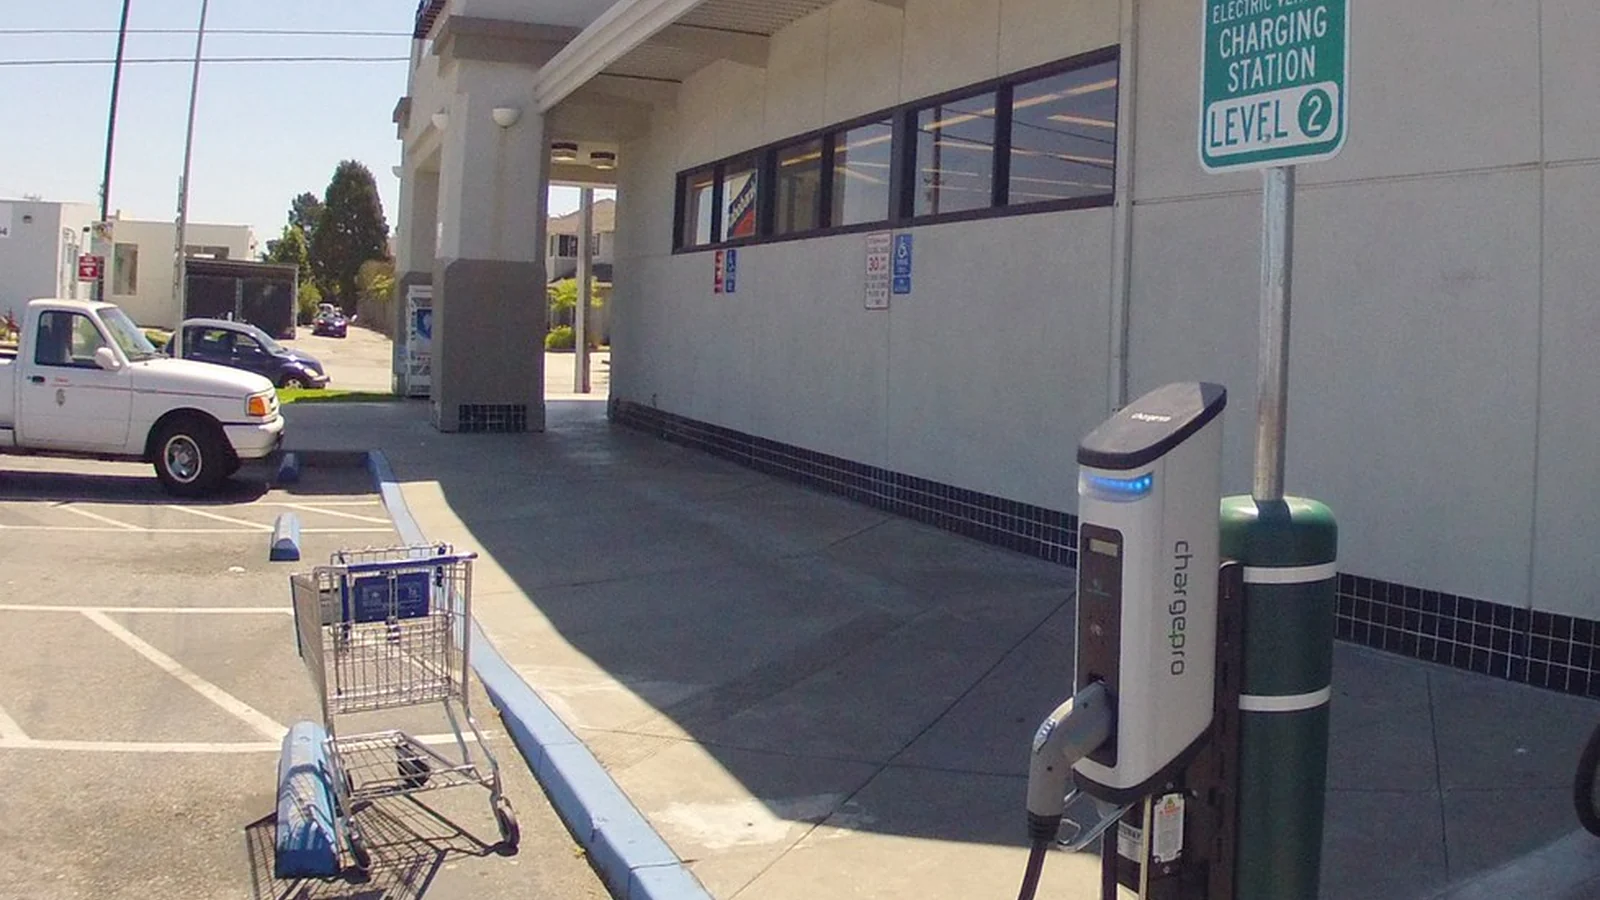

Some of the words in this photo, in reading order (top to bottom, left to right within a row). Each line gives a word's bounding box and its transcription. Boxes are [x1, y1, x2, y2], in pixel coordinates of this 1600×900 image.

[1213, 0, 1272, 24] ELECTRIC
[1219, 6, 1327, 58] CHARGING
[1227, 45, 1316, 92] STATION
[1210, 99, 1288, 148] LEVEL
[1307, 95, 1322, 132] 2
[1168, 540, 1193, 675] chargepro
